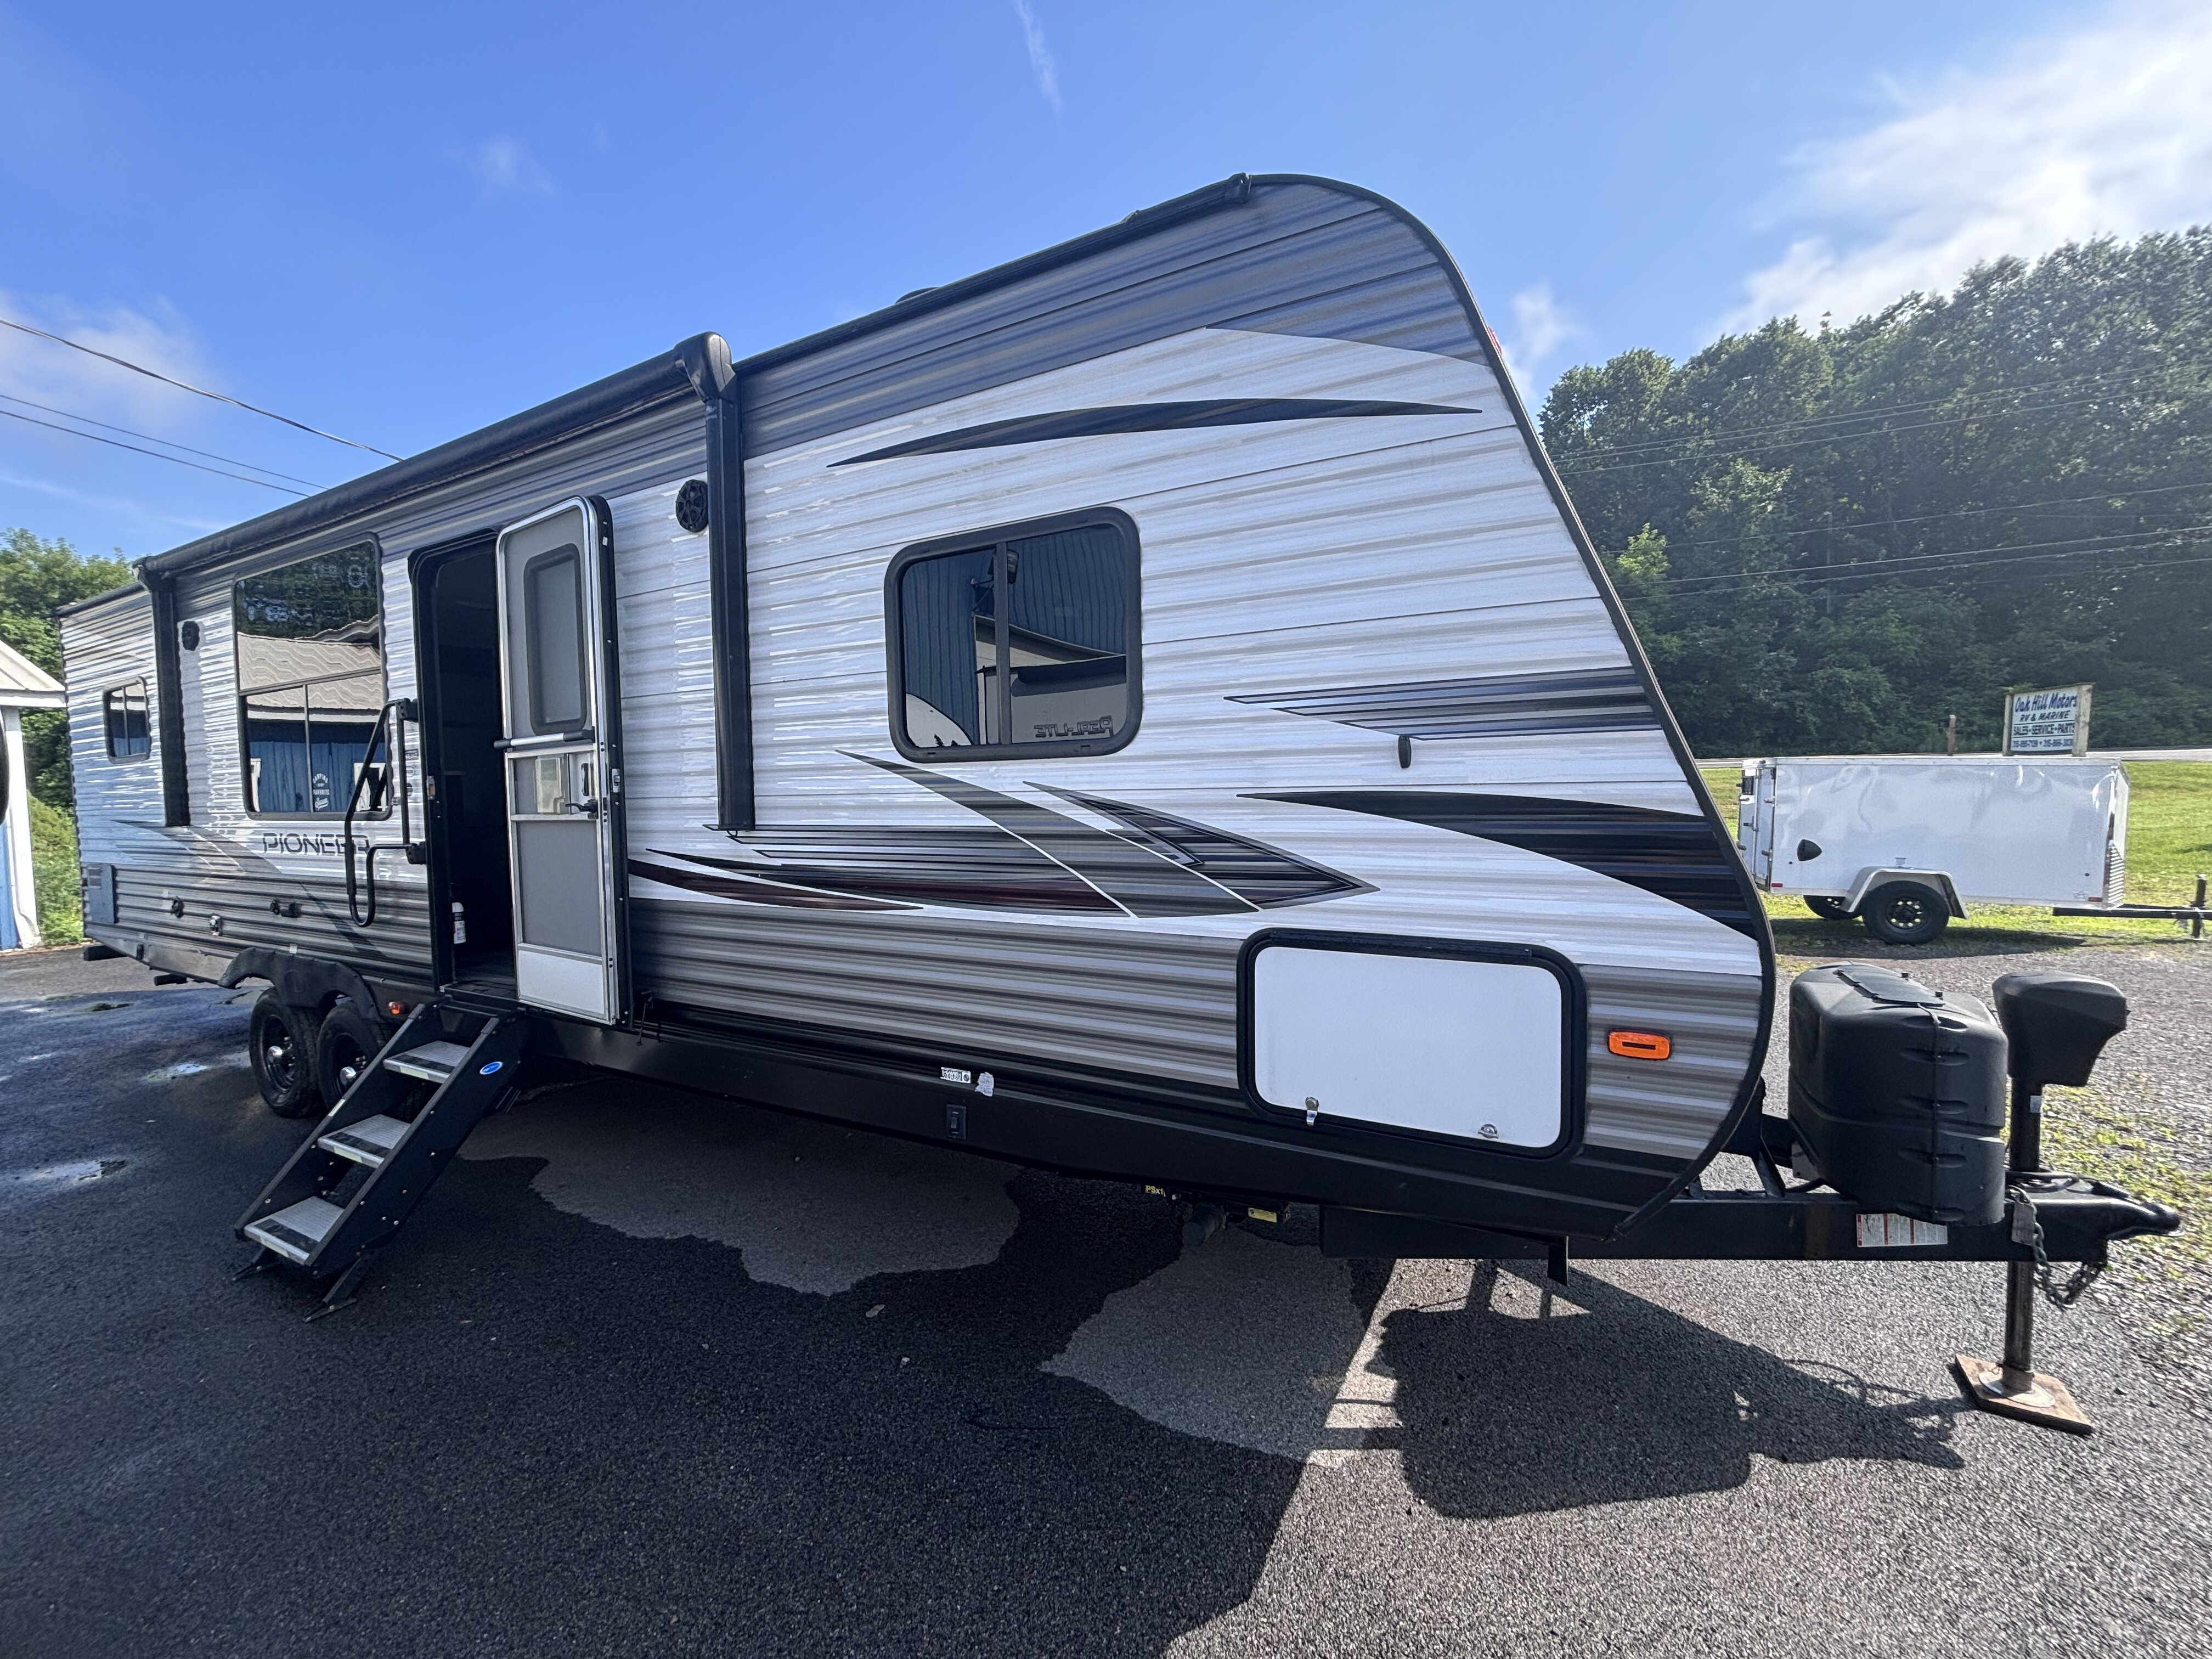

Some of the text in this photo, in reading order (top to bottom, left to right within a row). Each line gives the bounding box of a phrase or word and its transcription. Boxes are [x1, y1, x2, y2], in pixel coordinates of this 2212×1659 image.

[2015, 692, 2078, 712] Oak Hill Motors
[2019, 714, 2030, 722] RV
[2038, 710, 2070, 720] MARINE
